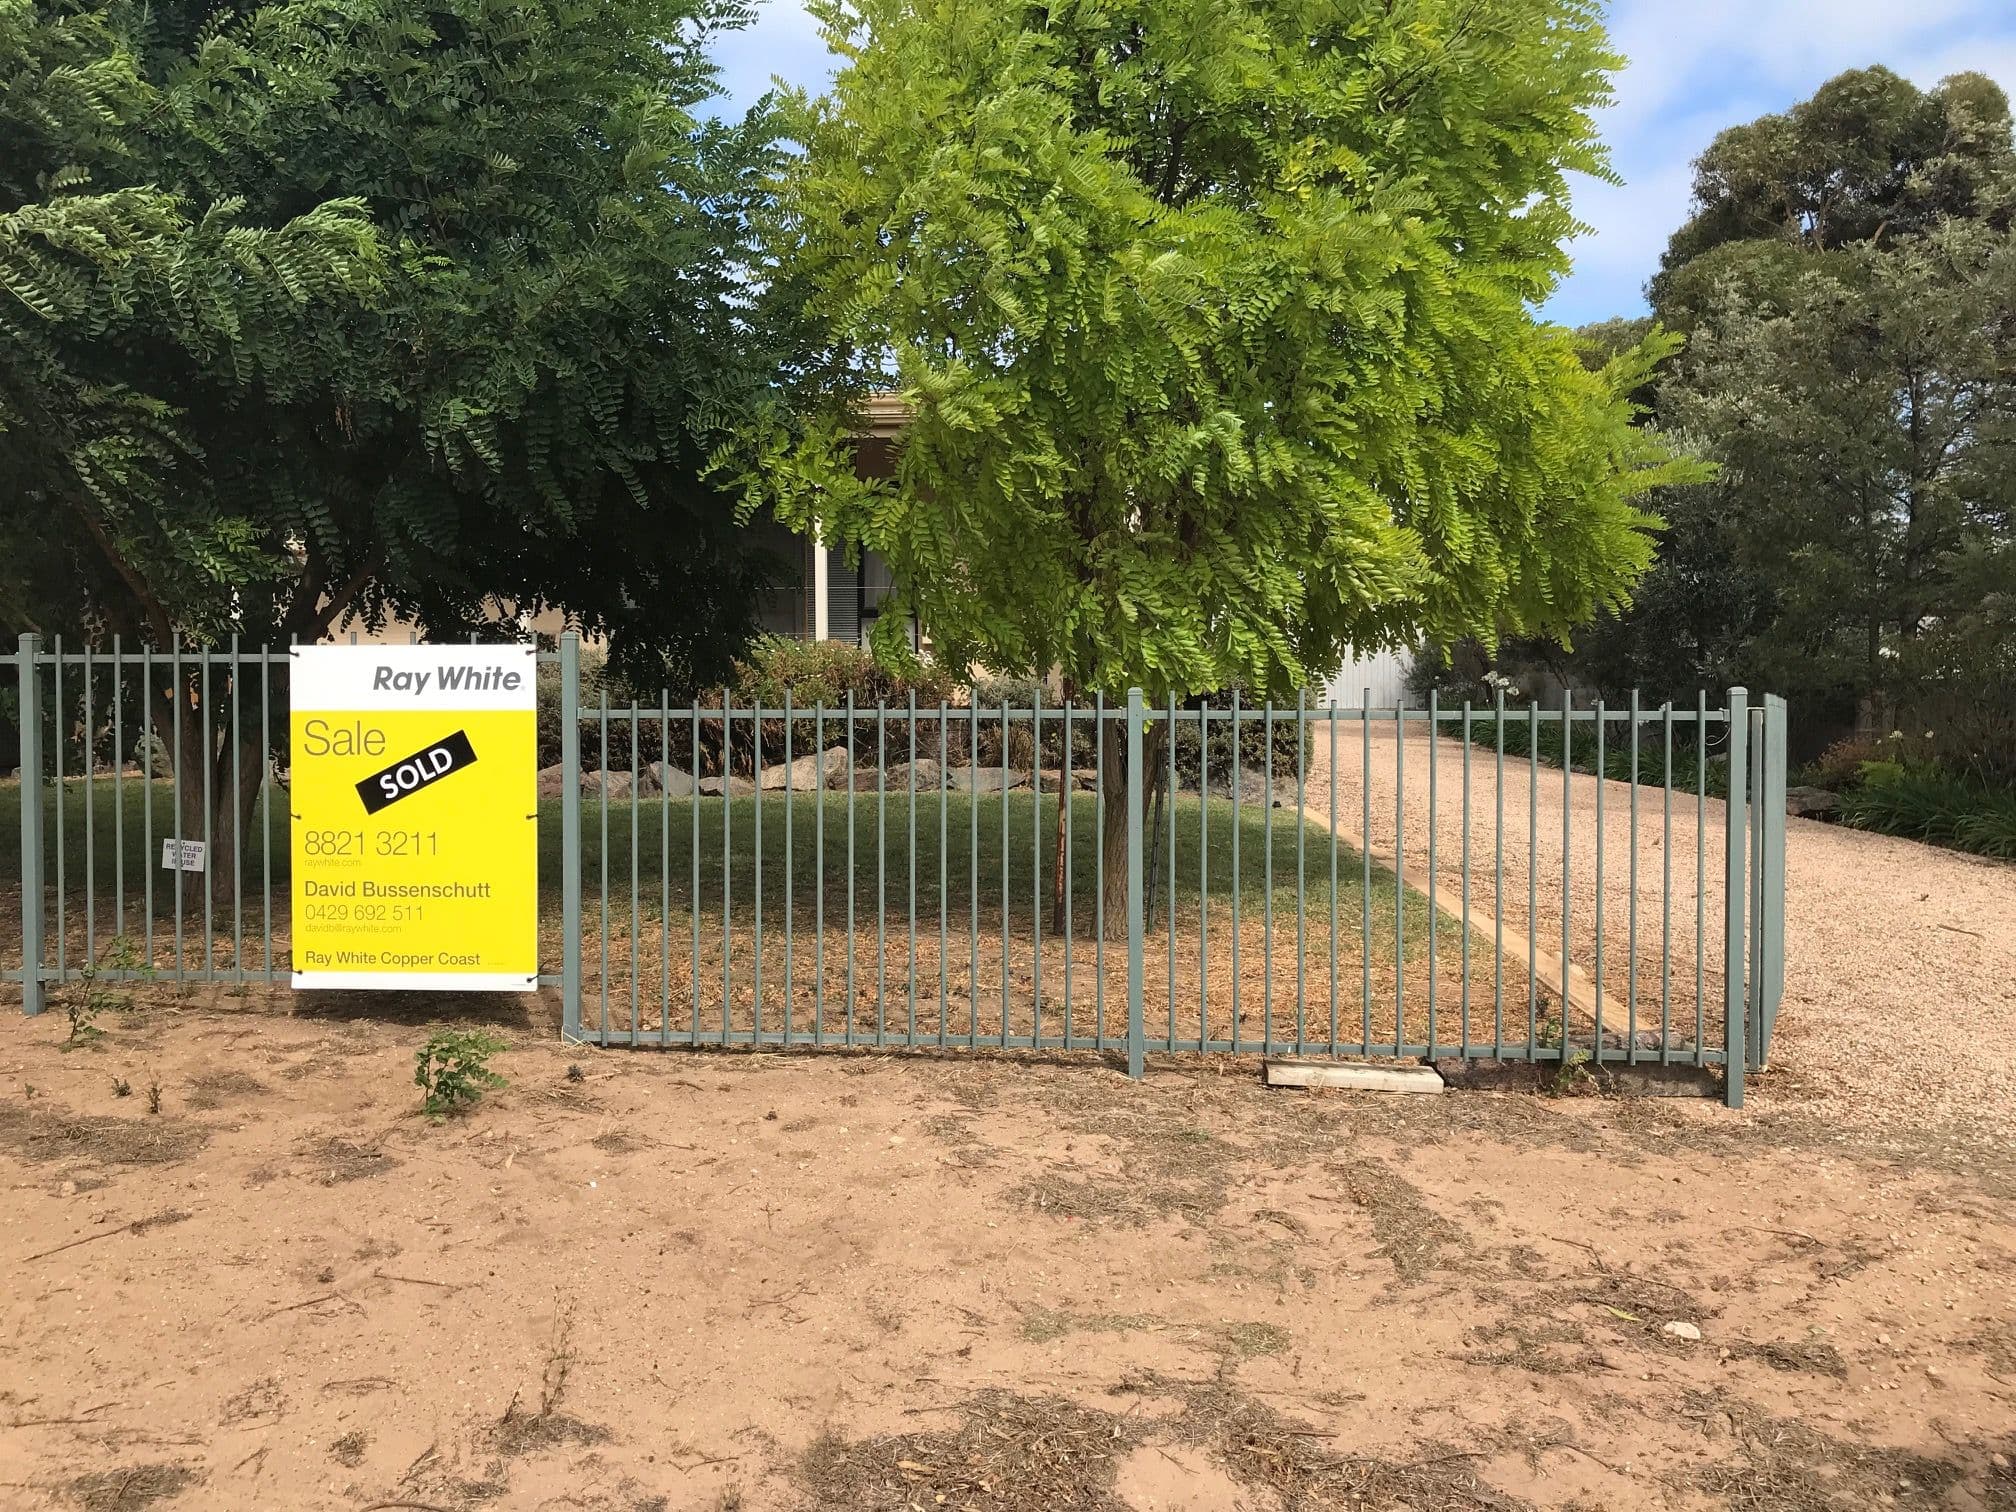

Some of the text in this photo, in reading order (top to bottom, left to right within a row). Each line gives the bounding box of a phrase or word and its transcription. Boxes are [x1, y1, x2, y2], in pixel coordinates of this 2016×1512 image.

[373, 666, 521, 695] Ray White
[304, 720, 385, 757] Sale
[379, 747, 453, 799] SOLD
[166, 843, 203, 853] REYCLED
[305, 831, 438, 856] 8821 3211
[304, 857, 361, 868] raywhite.com
[305, 880, 490, 898] David Bussenschutt
[305, 904, 424, 921] 0429 692 511
[305, 951, 481, 968] Ray White Copper Coast
